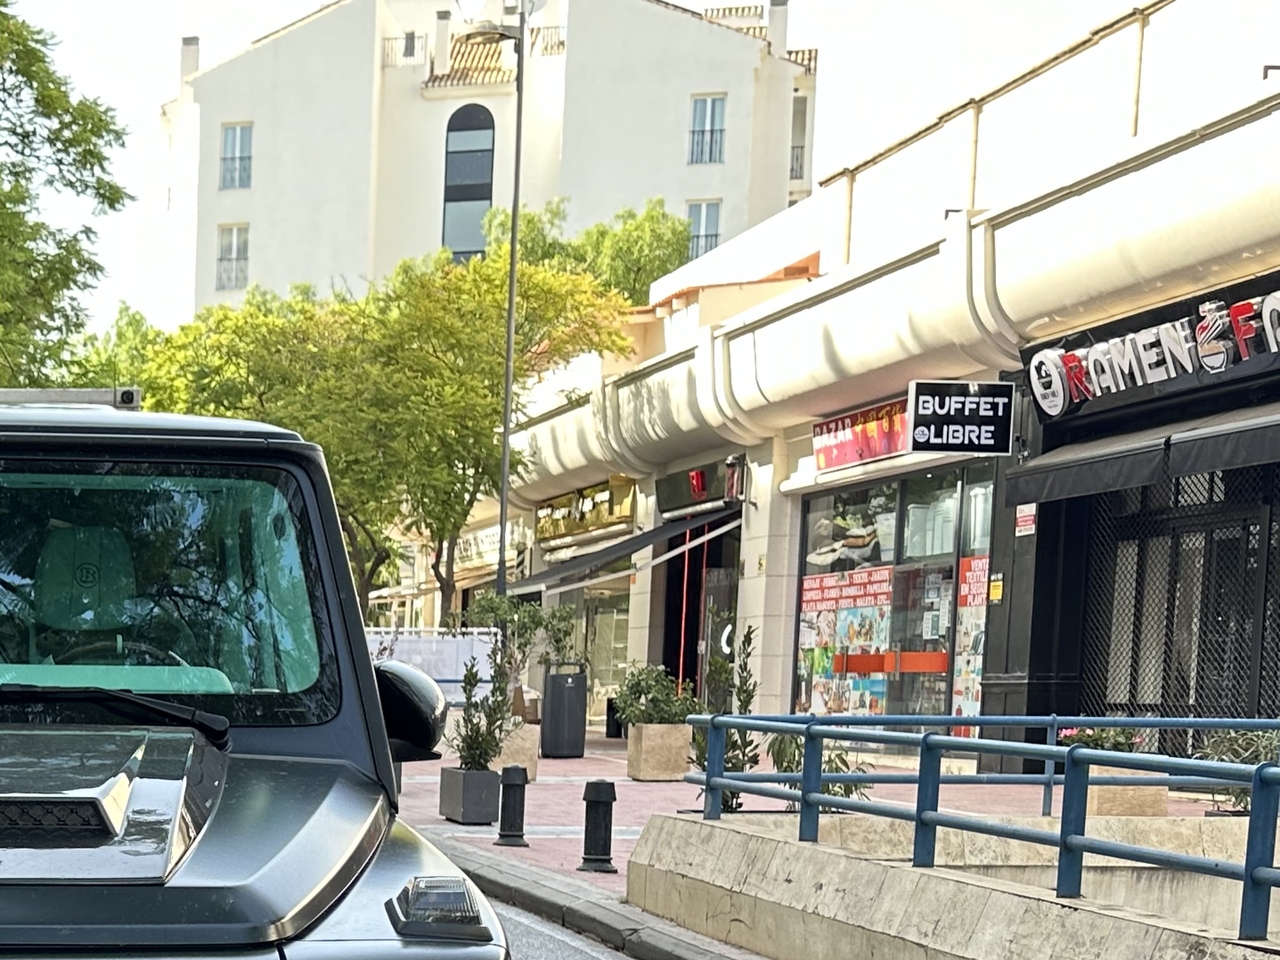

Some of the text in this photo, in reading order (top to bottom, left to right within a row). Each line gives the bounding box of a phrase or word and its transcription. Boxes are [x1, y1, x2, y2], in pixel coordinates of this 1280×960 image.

[1062, 316, 1194, 403] RAMEN
[918, 395, 1009, 416] BUFFET
[813, 417, 854, 450] BAZAR
[929, 425, 995, 445] LIBRE
